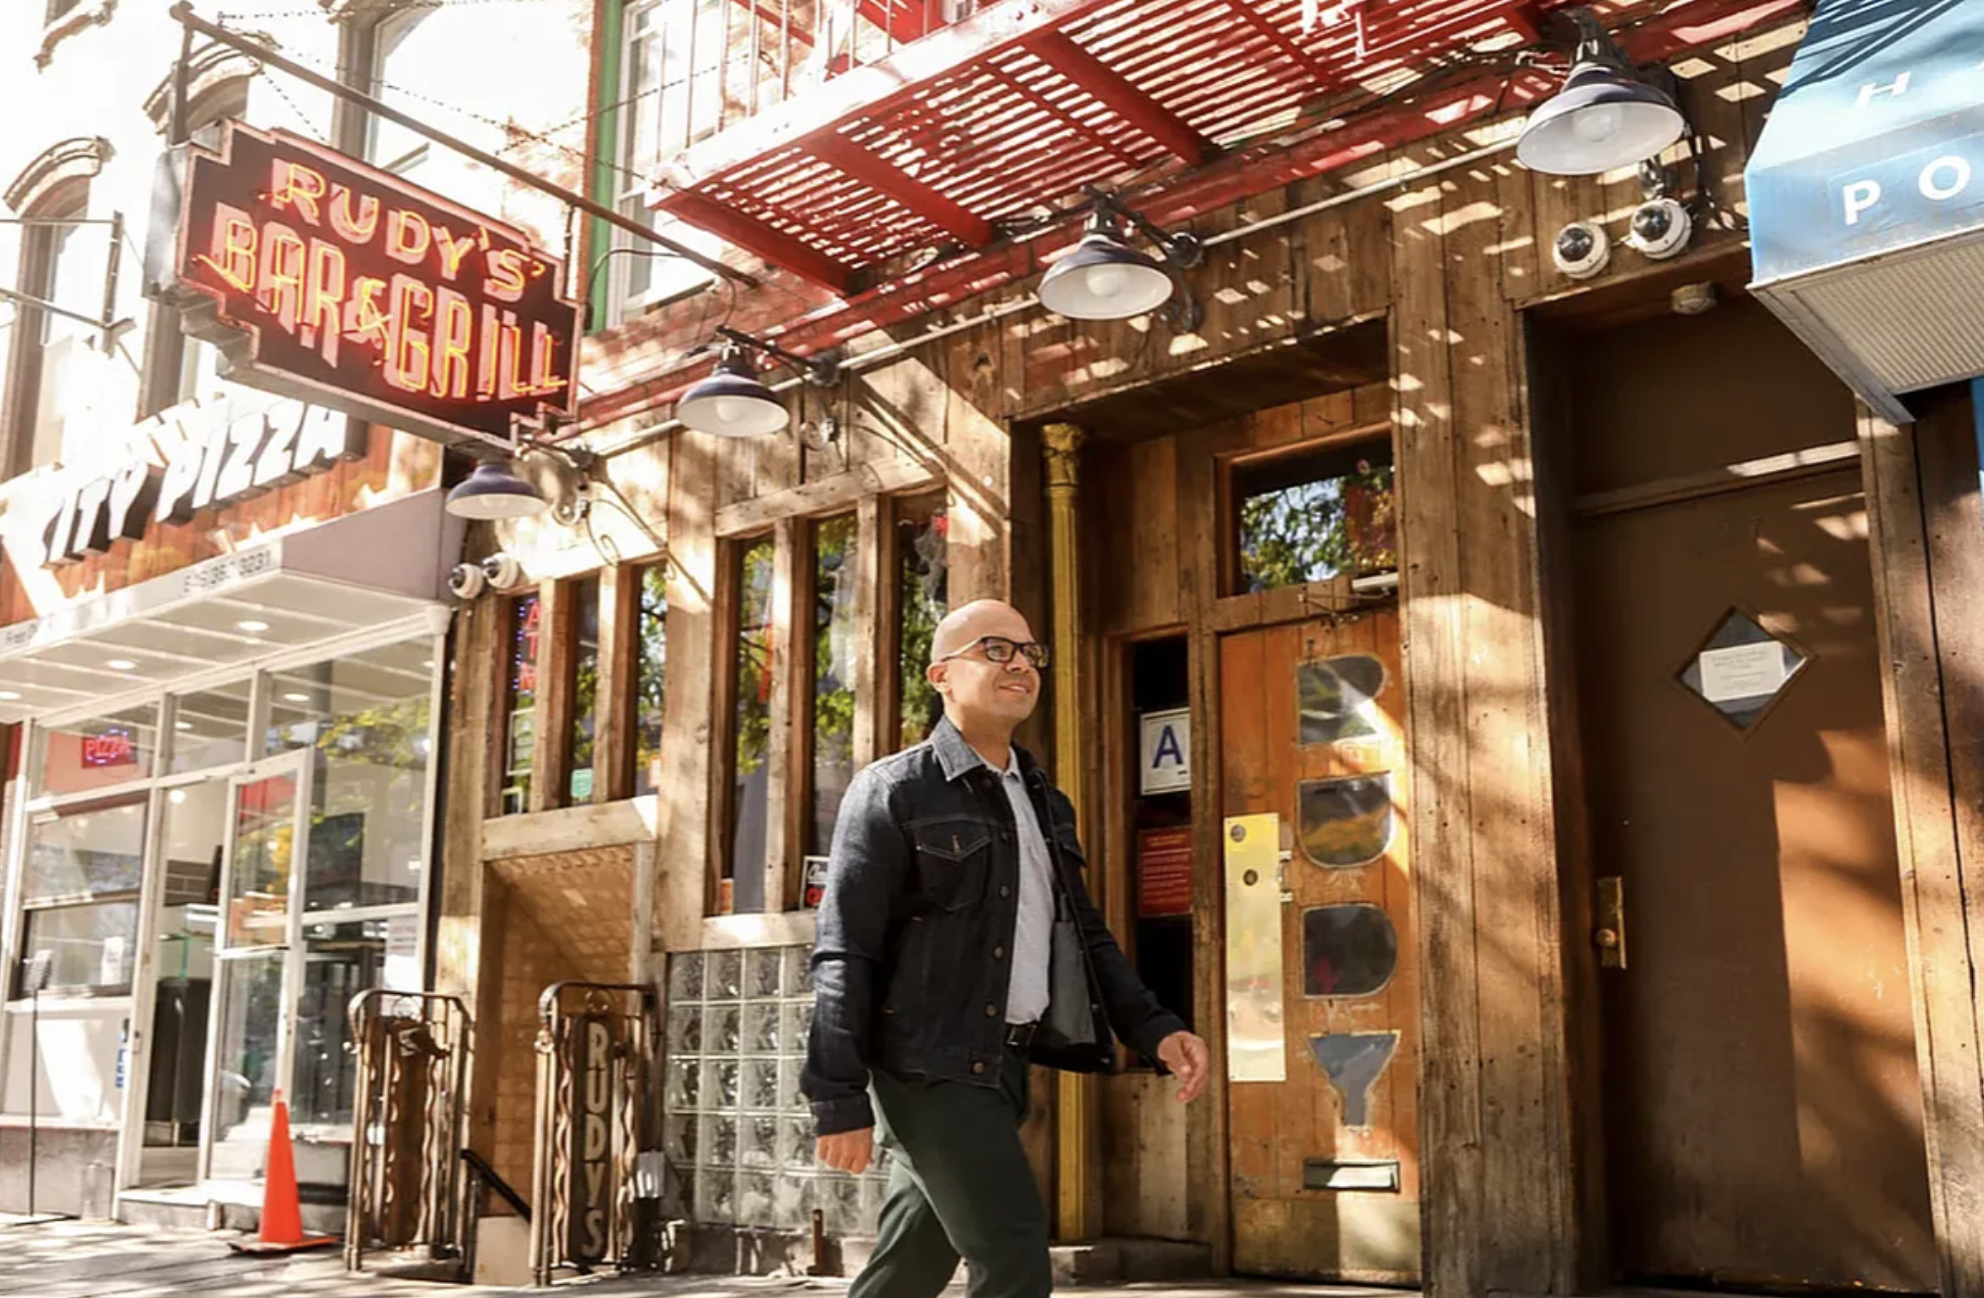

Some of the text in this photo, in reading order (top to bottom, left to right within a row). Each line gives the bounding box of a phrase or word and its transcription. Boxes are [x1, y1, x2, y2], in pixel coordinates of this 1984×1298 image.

[265, 157, 540, 302] RUDY'S
[154, 400, 348, 523] PIZZA
[1151, 724, 1184, 769] A
[582, 1021, 610, 1257] RUDYS
